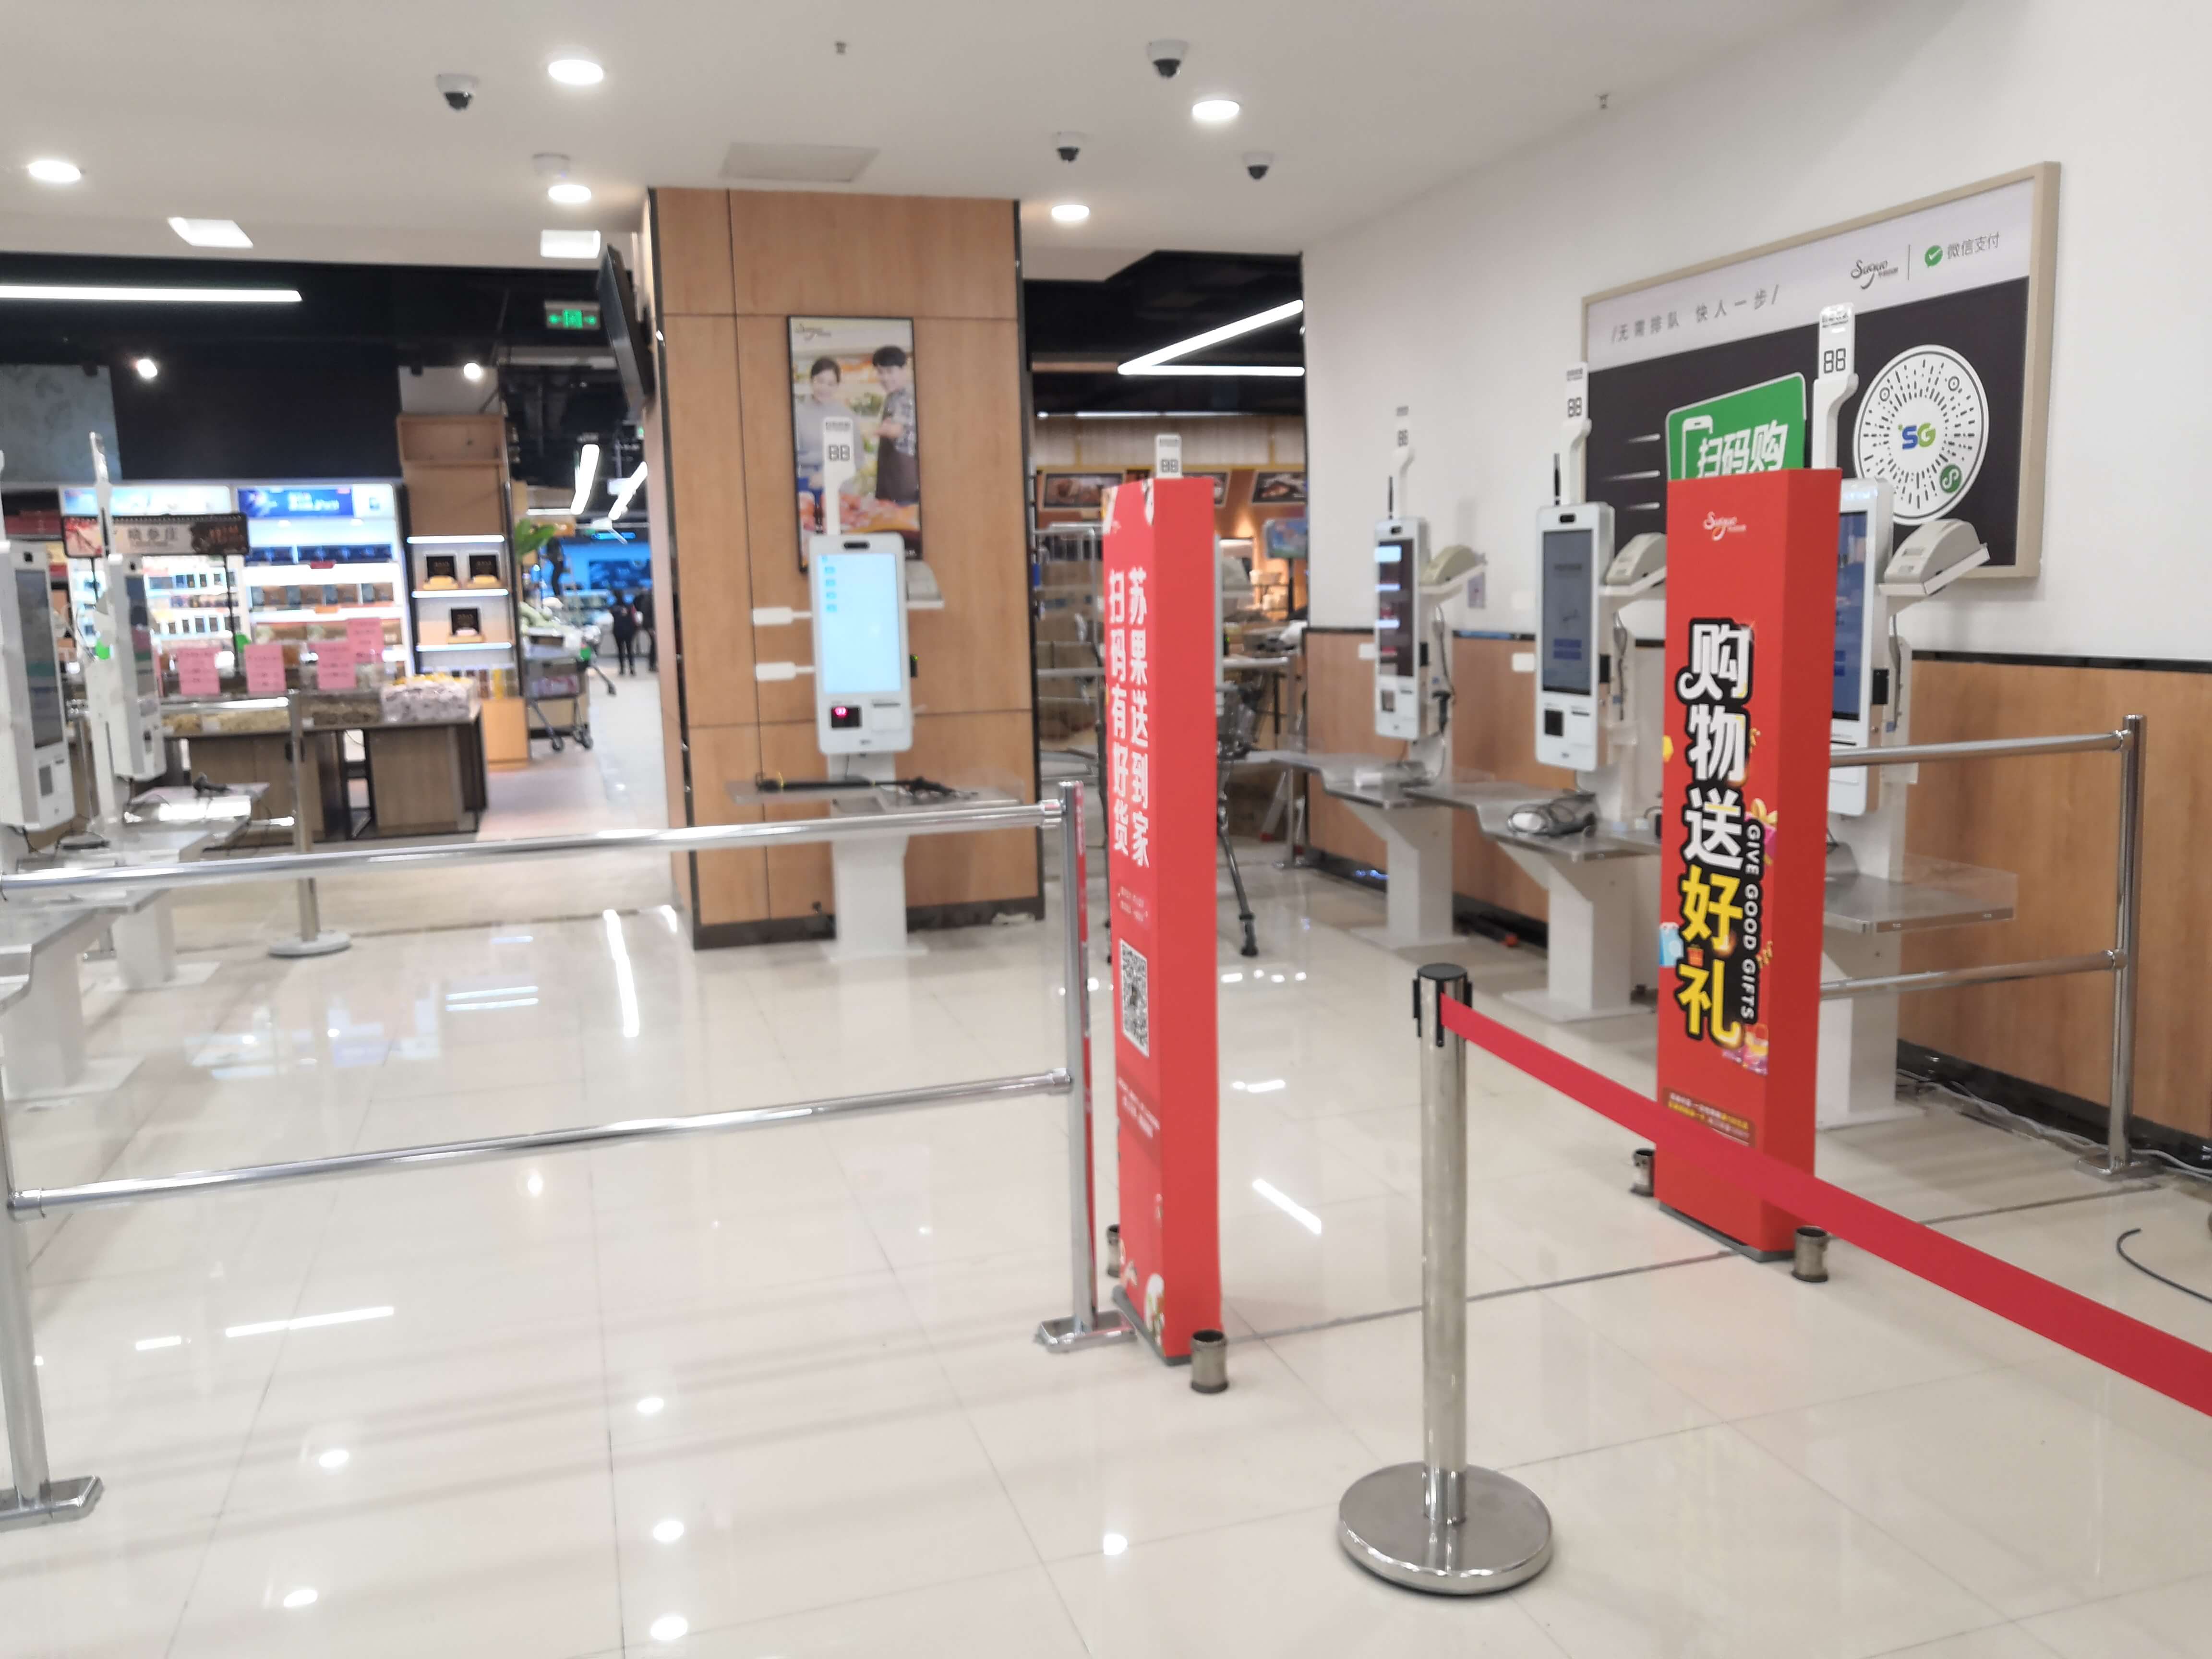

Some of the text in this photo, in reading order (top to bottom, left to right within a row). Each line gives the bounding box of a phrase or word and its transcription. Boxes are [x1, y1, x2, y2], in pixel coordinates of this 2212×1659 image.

[1947, 231, 2000, 259] 微信支付
[1696, 419, 1788, 479] 扫码购
[1129, 566, 1150, 868] 苏果送到家
[1676, 619, 1753, 1047] 购物送好礼
[1740, 823, 1761, 1020] GIVE GOOD GIFTS
